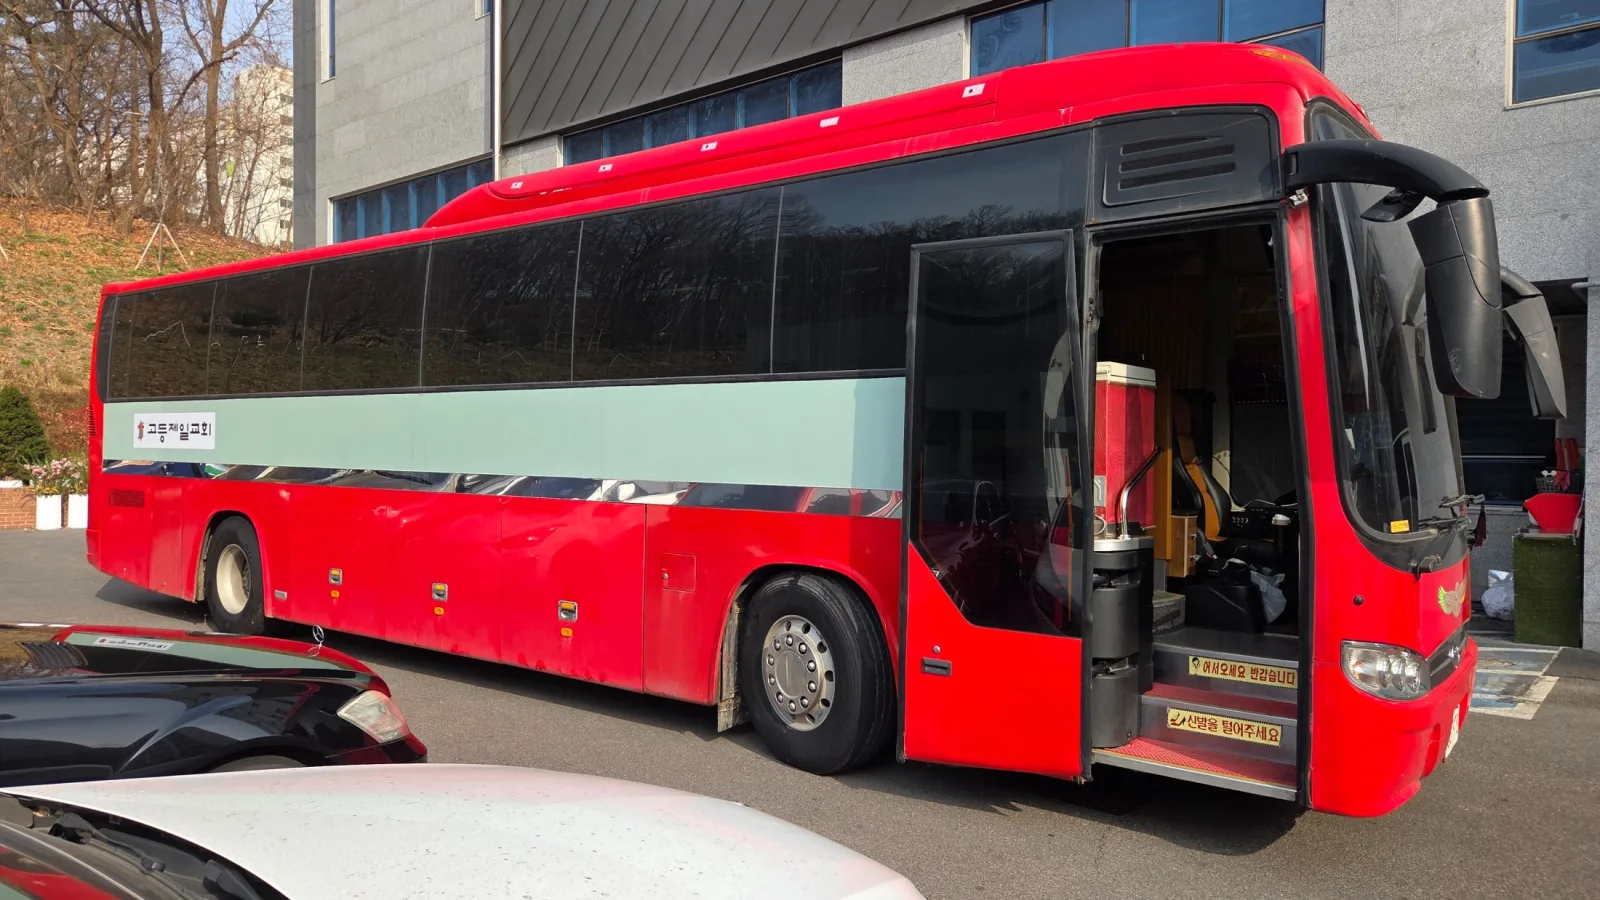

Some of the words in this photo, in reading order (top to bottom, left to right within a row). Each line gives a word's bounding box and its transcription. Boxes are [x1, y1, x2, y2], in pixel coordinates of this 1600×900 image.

[147, 421, 212, 443] 고등제일교회
[1203, 660, 1246, 678] 어서오세요
[1250, 666, 1296, 686] 반갑습니다
[1187, 714, 1218, 733] 신발을
[1222, 720, 1279, 743] 털어주세요
